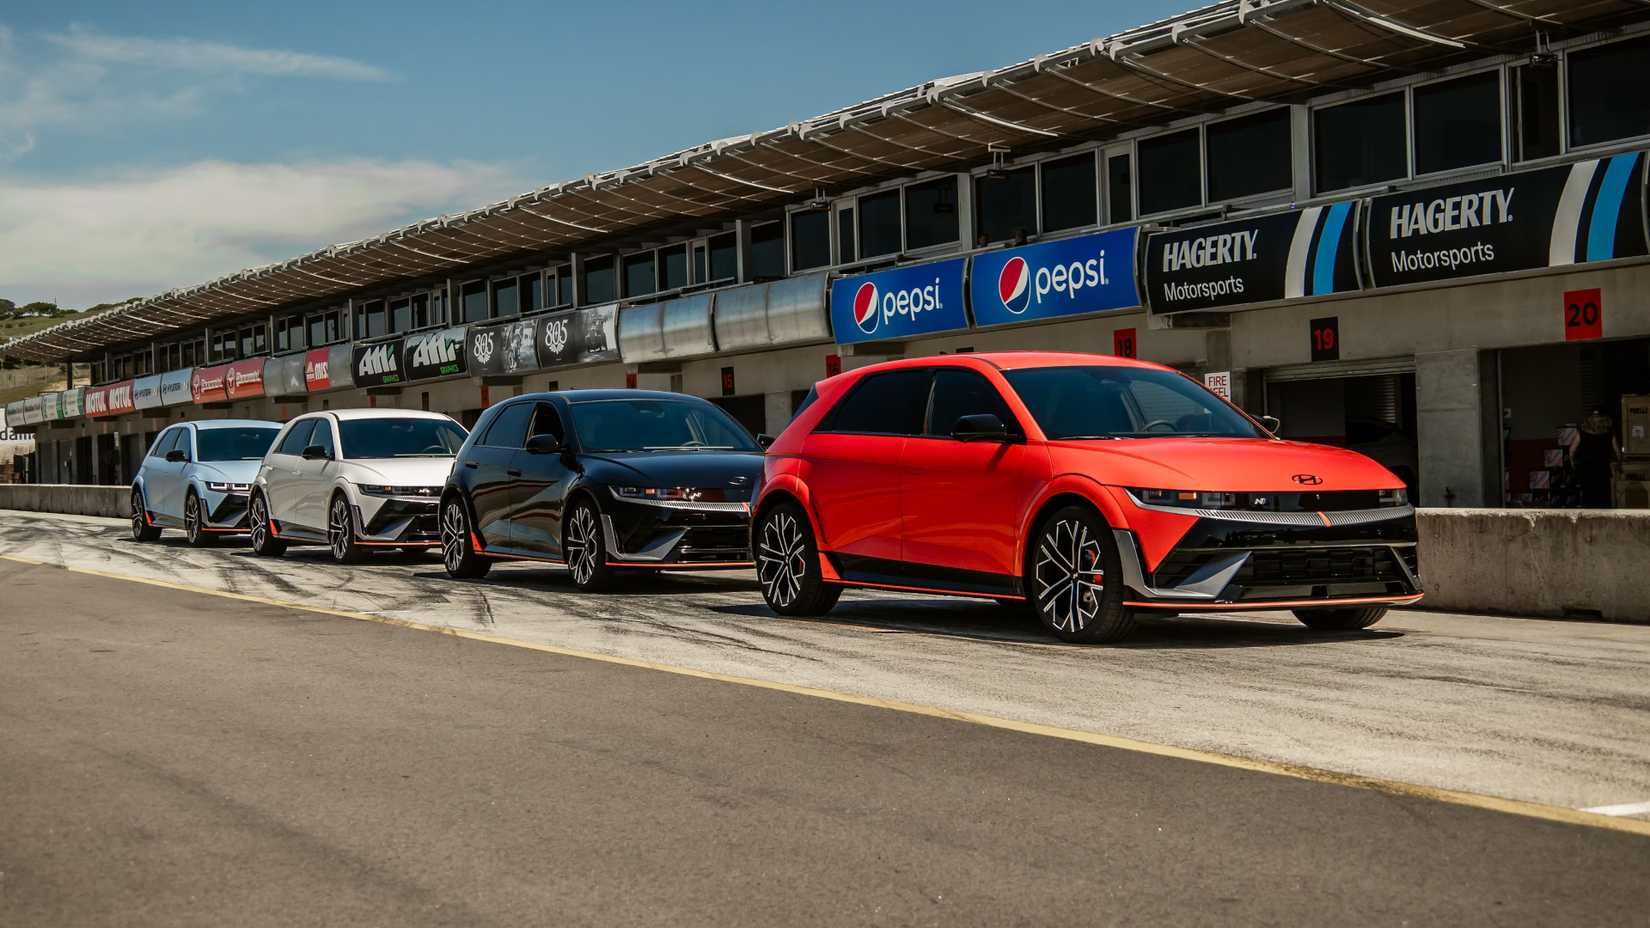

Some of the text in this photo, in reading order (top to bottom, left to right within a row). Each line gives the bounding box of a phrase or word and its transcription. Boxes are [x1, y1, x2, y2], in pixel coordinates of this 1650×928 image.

[1390, 187, 1514, 239] HAGERTY
[1163, 229, 1258, 272] HAGERTY
[1391, 241, 1495, 272] Motorsports
[1035, 250, 1106, 304] pepsi
[1163, 275, 1244, 301] Motorsports
[883, 277, 941, 325] pepsi
[1567, 302, 1600, 327] 20
[473, 332, 494, 357] 805
[545, 319, 569, 346] 805
[1313, 328, 1335, 351] 19
[1118, 336, 1132, 357] 18
[1208, 375, 1227, 387] FIRE
[85, 391, 107, 413] MOTUL
[109, 385, 132, 409] MOTUL
